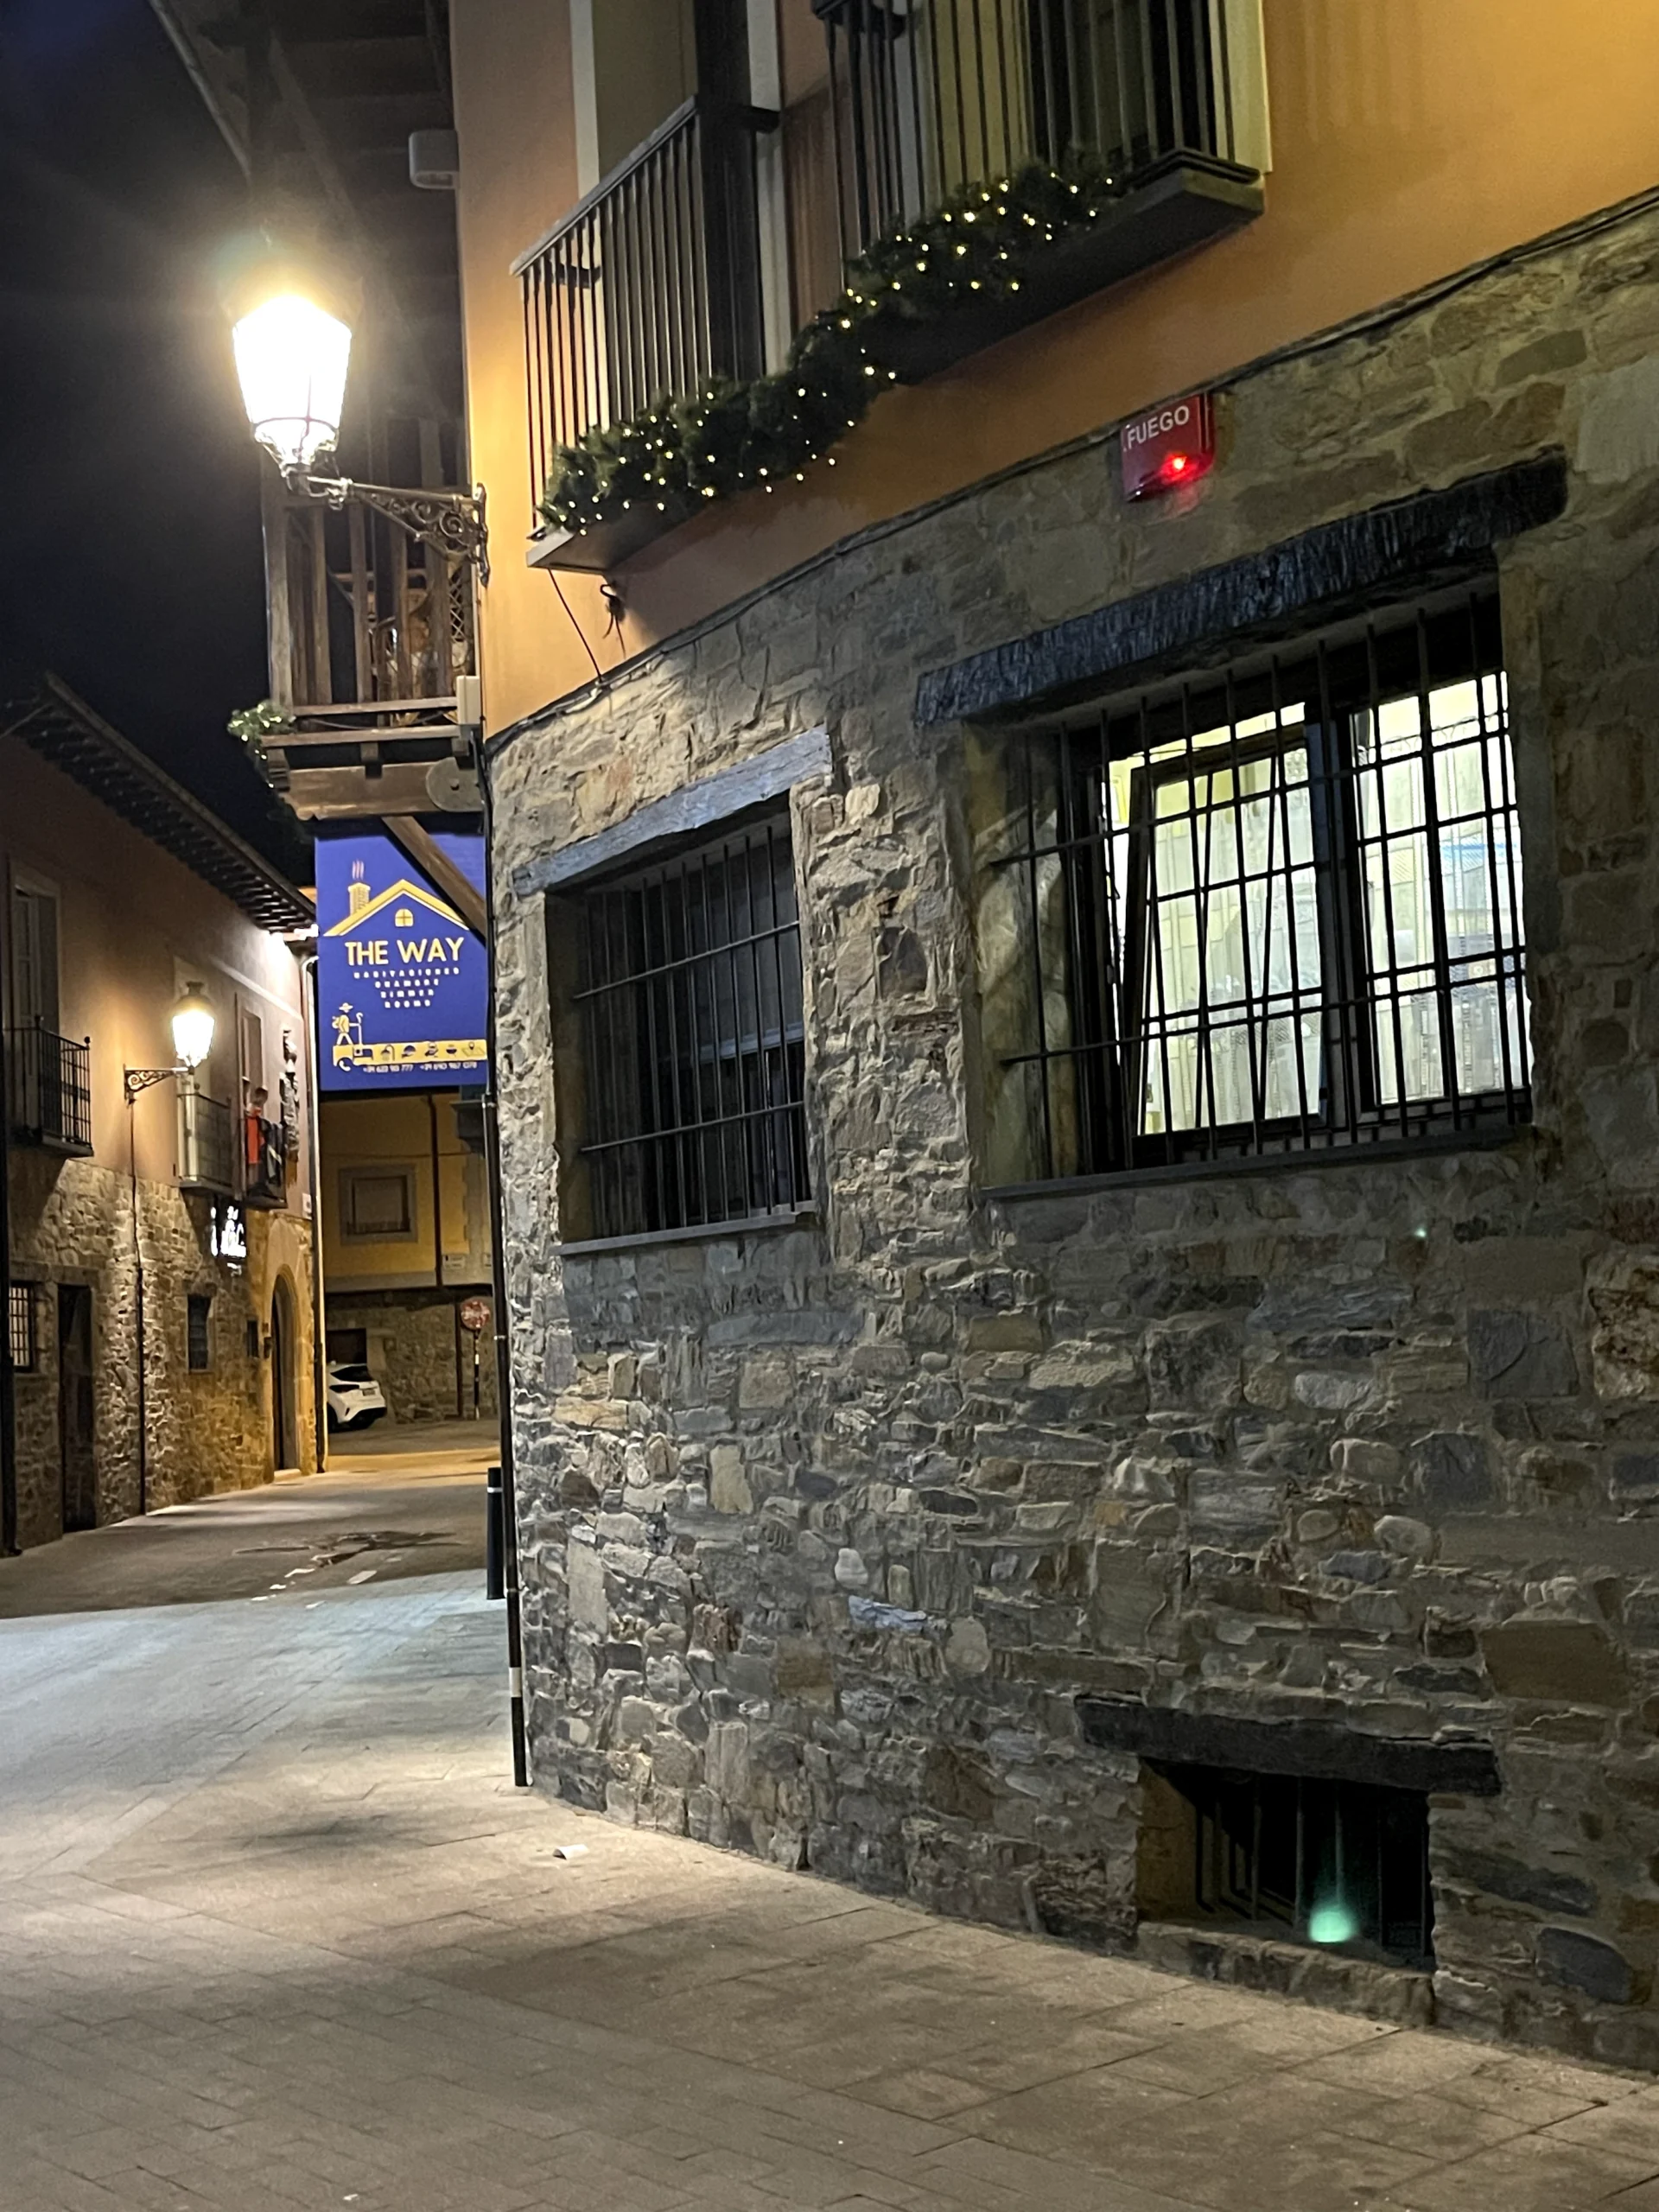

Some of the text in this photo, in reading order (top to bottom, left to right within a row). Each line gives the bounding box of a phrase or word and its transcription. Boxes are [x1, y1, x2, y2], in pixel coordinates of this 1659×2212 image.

[1127, 405, 1190, 449] FUEGO
[345, 937, 465, 966] THE WAY
